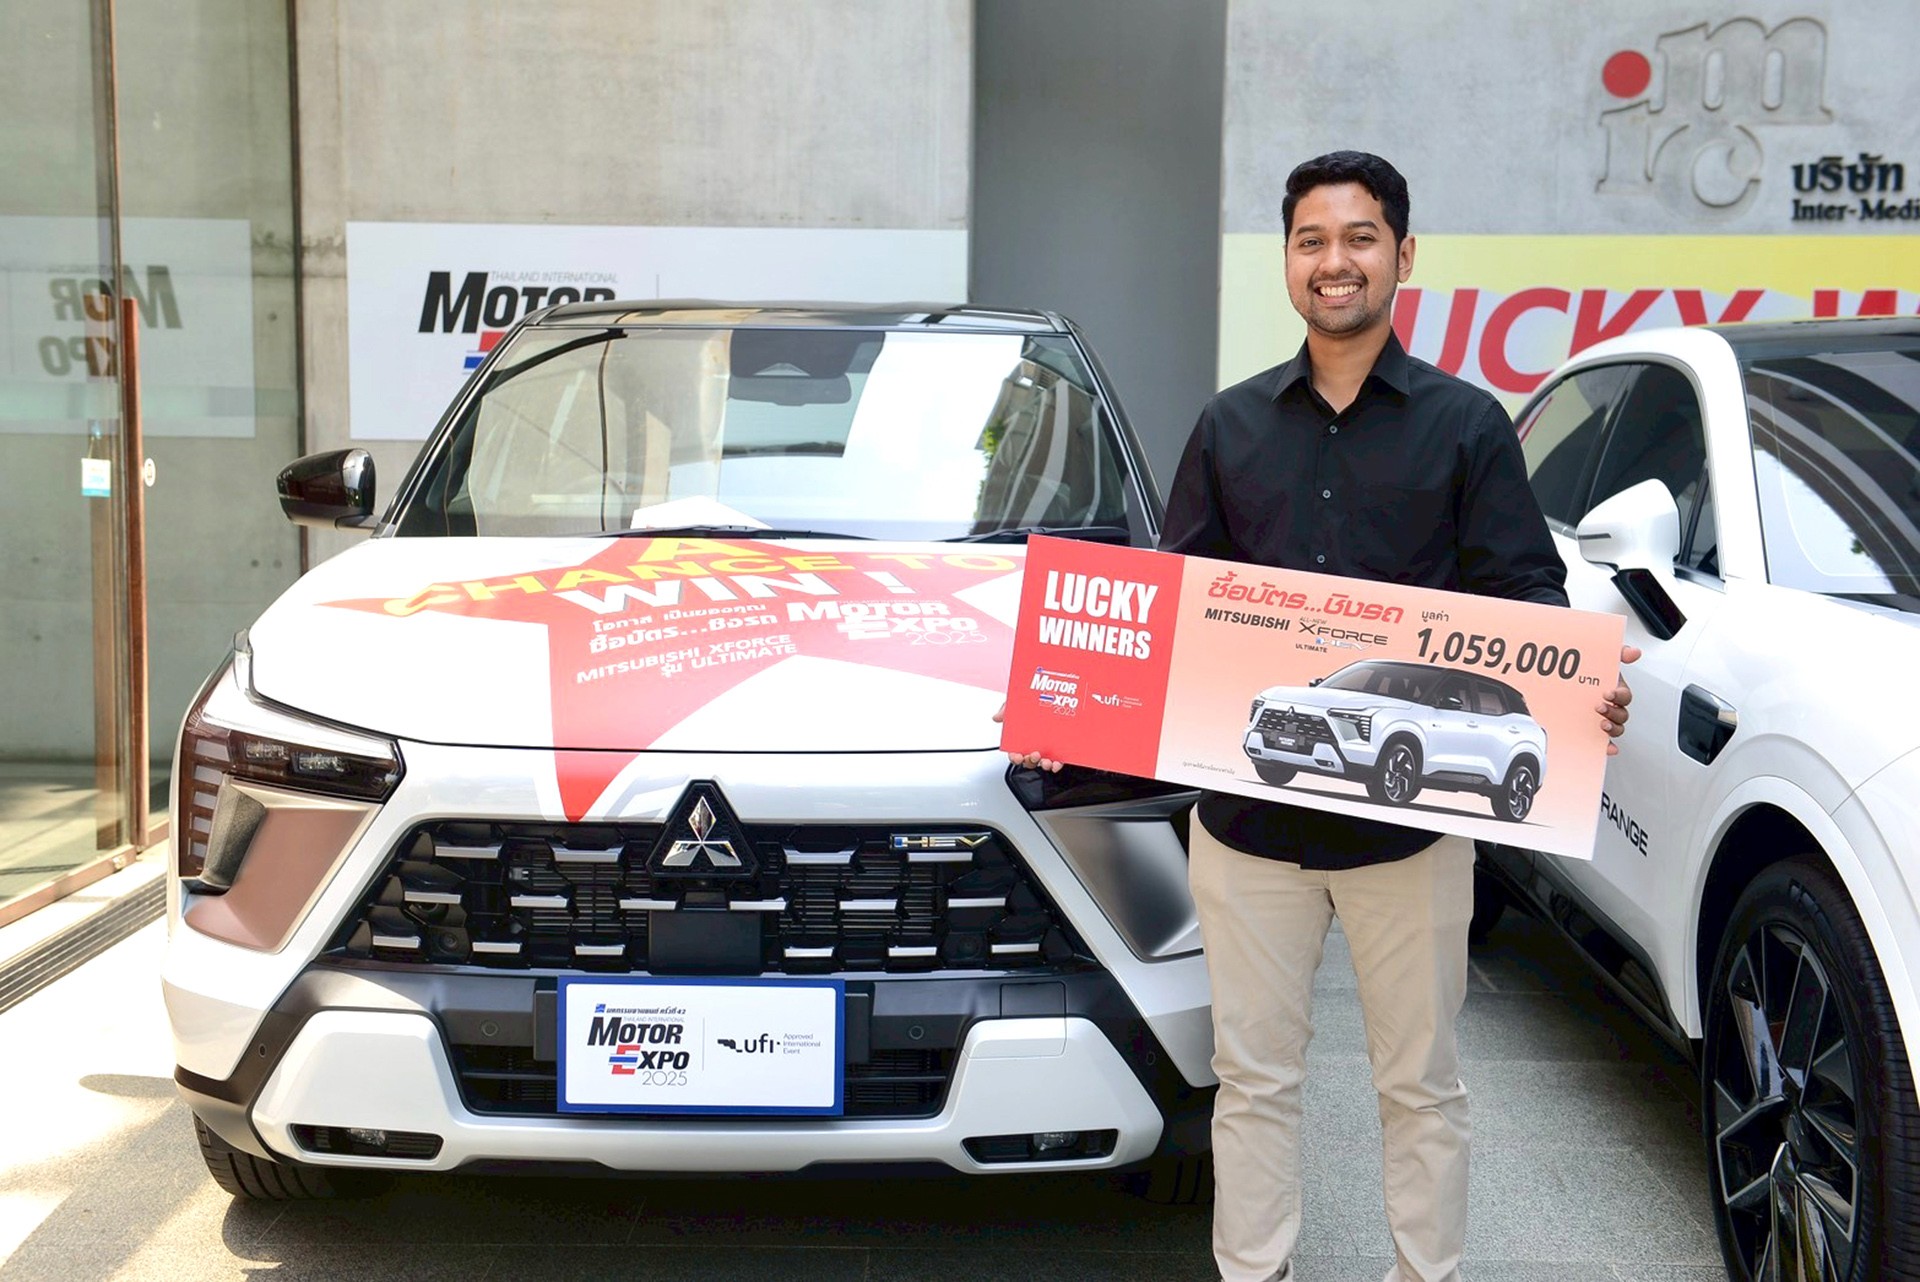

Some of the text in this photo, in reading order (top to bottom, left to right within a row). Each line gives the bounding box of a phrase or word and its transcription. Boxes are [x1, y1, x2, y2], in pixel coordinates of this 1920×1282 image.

[1792, 153, 1904, 192] บริษัท
[491, 271, 618, 284] THAILAND INTERNATIONAL
[637, 538, 768, 563] A
[868, 553, 1018, 571] TO
[1044, 569, 1158, 625] LUCKY
[786, 601, 951, 622] MOTOR
[1204, 607, 1291, 631] MITSUBISHI
[1421, 609, 1450, 623] มูลค่า
[836, 616, 979, 640] EXPO
[905, 631, 988, 646] 2025
[1039, 615, 1152, 660] WINNERS
[1298, 621, 1389, 646] XFORCE
[576, 634, 792, 683] MITSUBISHI XFORCE
[691, 644, 797, 669] ULTIMATE
[1295, 643, 1328, 653] ULTIMATE
[1417, 627, 1601, 687] 1,059,000 บาท
[1030, 673, 1078, 695] MOTOR
[1053, 706, 1077, 717] 2025
[1601, 791, 1648, 857] RANGE
[587, 1016, 684, 1046] MOTOR
[783, 1033, 814, 1041] Approved
[608, 1044, 690, 1075] EXPO
[642, 1071, 687, 1087] 2025
